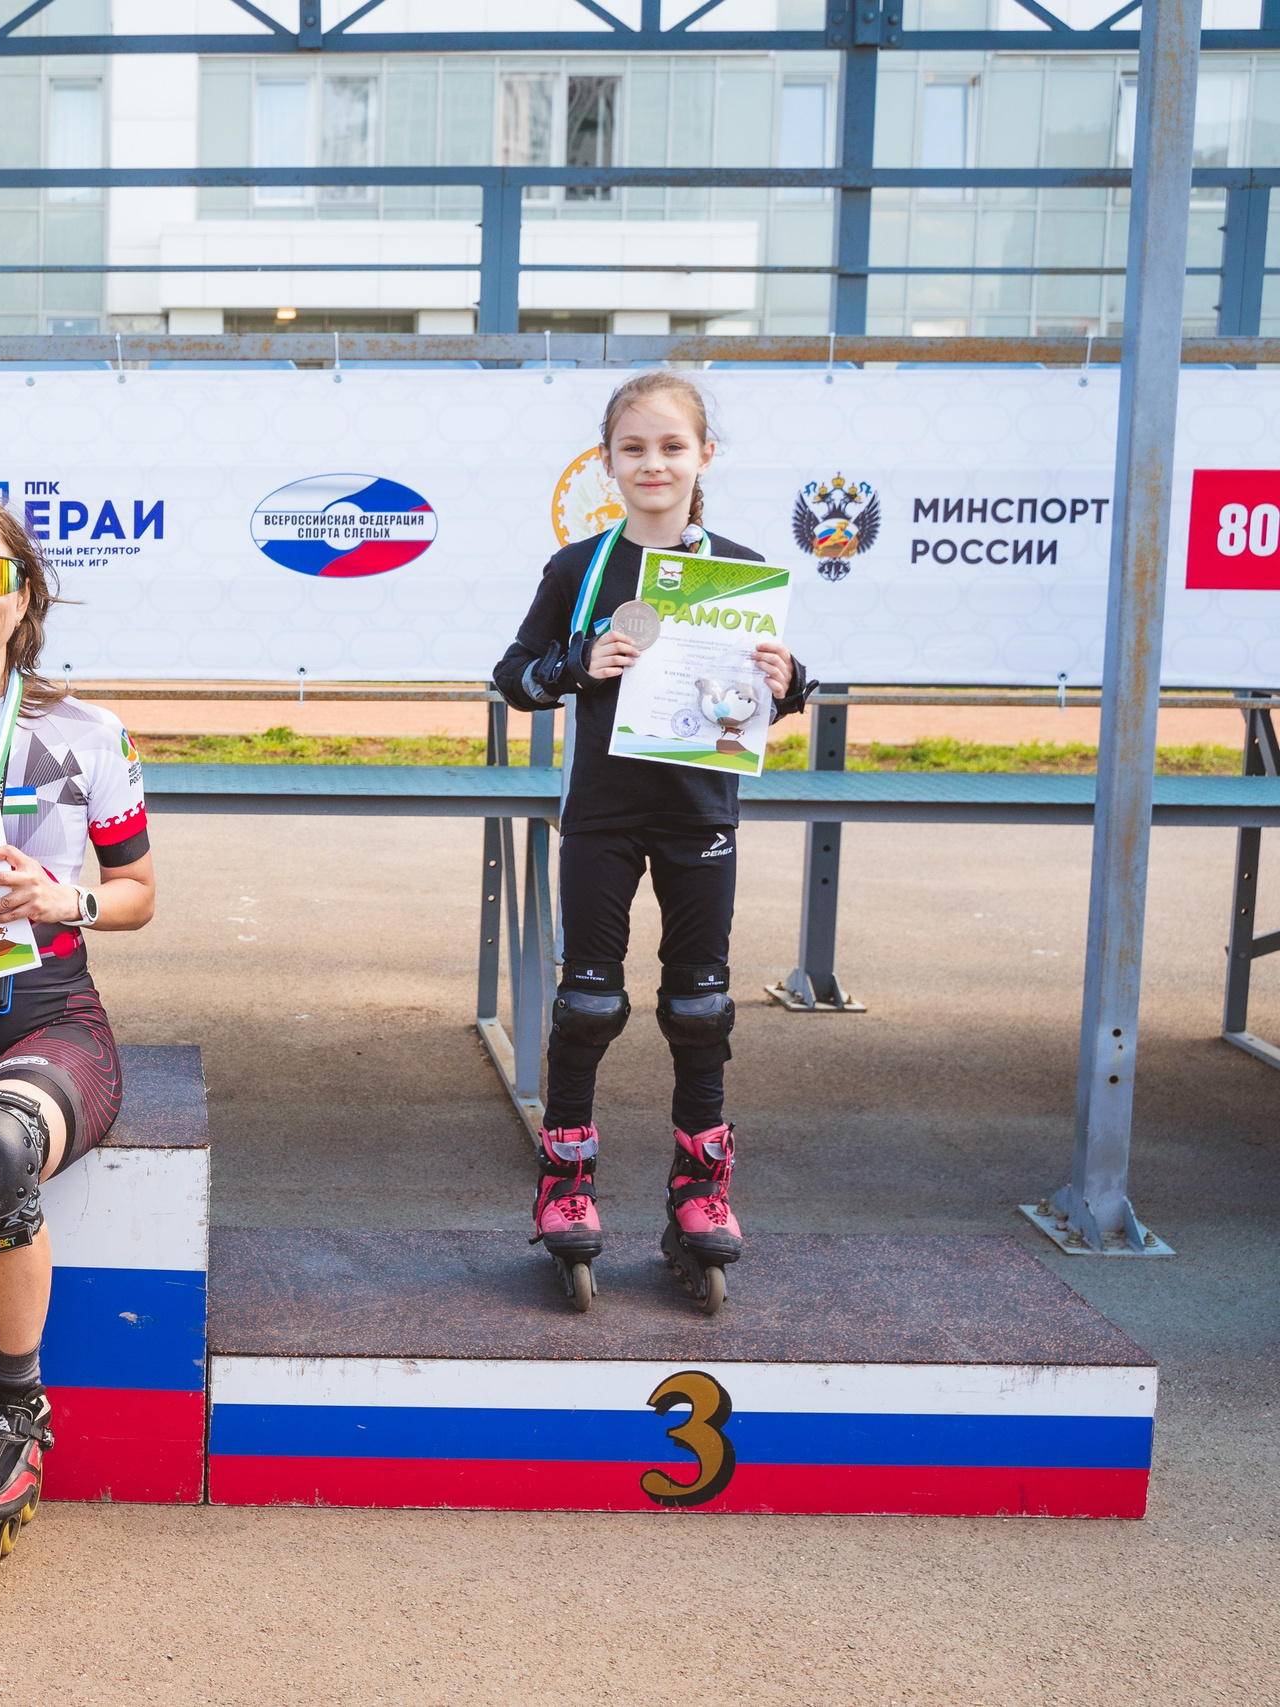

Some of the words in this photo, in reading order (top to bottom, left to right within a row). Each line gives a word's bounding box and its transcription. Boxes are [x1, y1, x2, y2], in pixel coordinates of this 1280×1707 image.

[24, 481, 60, 495] ППК
[913, 497, 1110, 524] МИНСПОРТ
[24, 500, 164, 541] ЕРАИ
[264, 513, 355, 526] ВСЕРОССИЙСКАЯ
[359, 514, 424, 527] ФЕДЕРАЦИЯ
[298, 527, 340, 539] СПОРТА
[344, 527, 390, 539] СЛЕПЫХ
[1217, 503, 1280, 557] 80
[77, 546, 140, 555] РЕГУЛЯТОР
[911, 539, 1058, 565] РОССИИ
[46, 559, 84, 567] РТНЫХ
[88, 559, 108, 567] ИГР
[701, 846, 733, 858] DEMIX
[640, 1370, 736, 1508] 3
